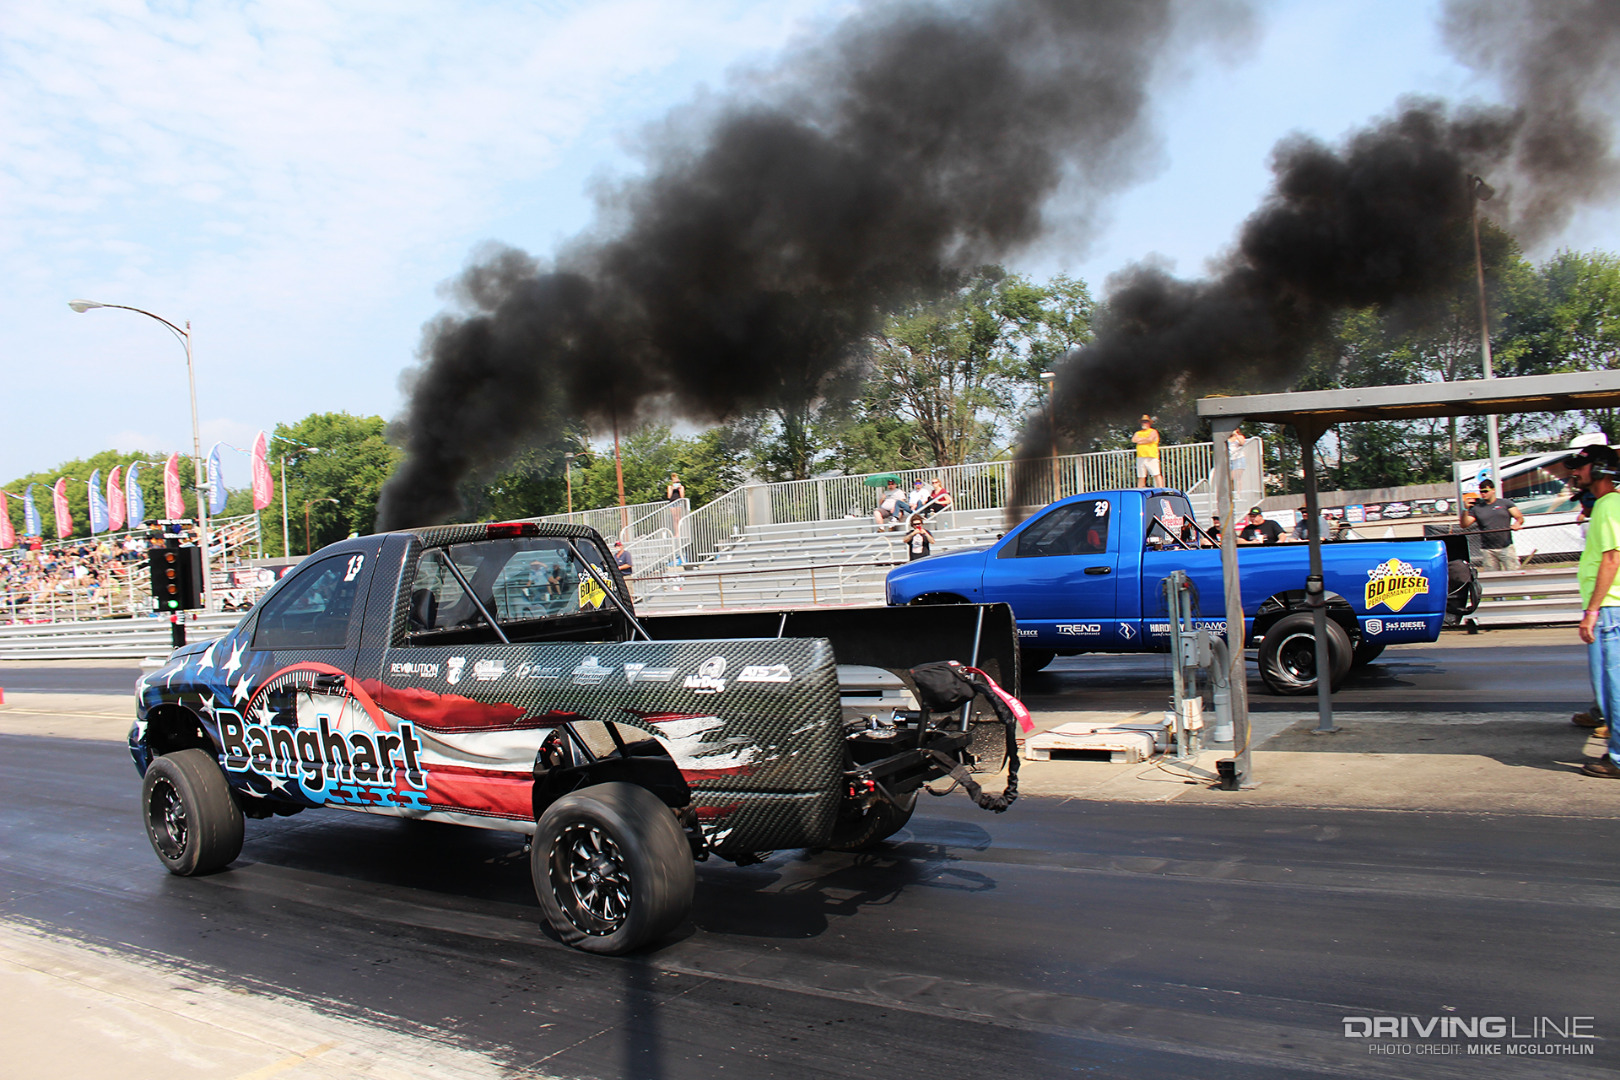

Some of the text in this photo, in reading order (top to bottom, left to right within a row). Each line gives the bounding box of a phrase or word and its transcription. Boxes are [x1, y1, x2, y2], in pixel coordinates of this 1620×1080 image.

[1094, 501, 1109, 513] 29
[347, 555, 364, 574] 13
[1368, 577, 1428, 599] BD DIESEL
[1056, 624, 1101, 635] TREND
[391, 662, 439, 674] REVOLUTION
[742, 666, 770, 677] ATS
[683, 675, 726, 692] AirDog
[216, 708, 428, 793] Banghart
